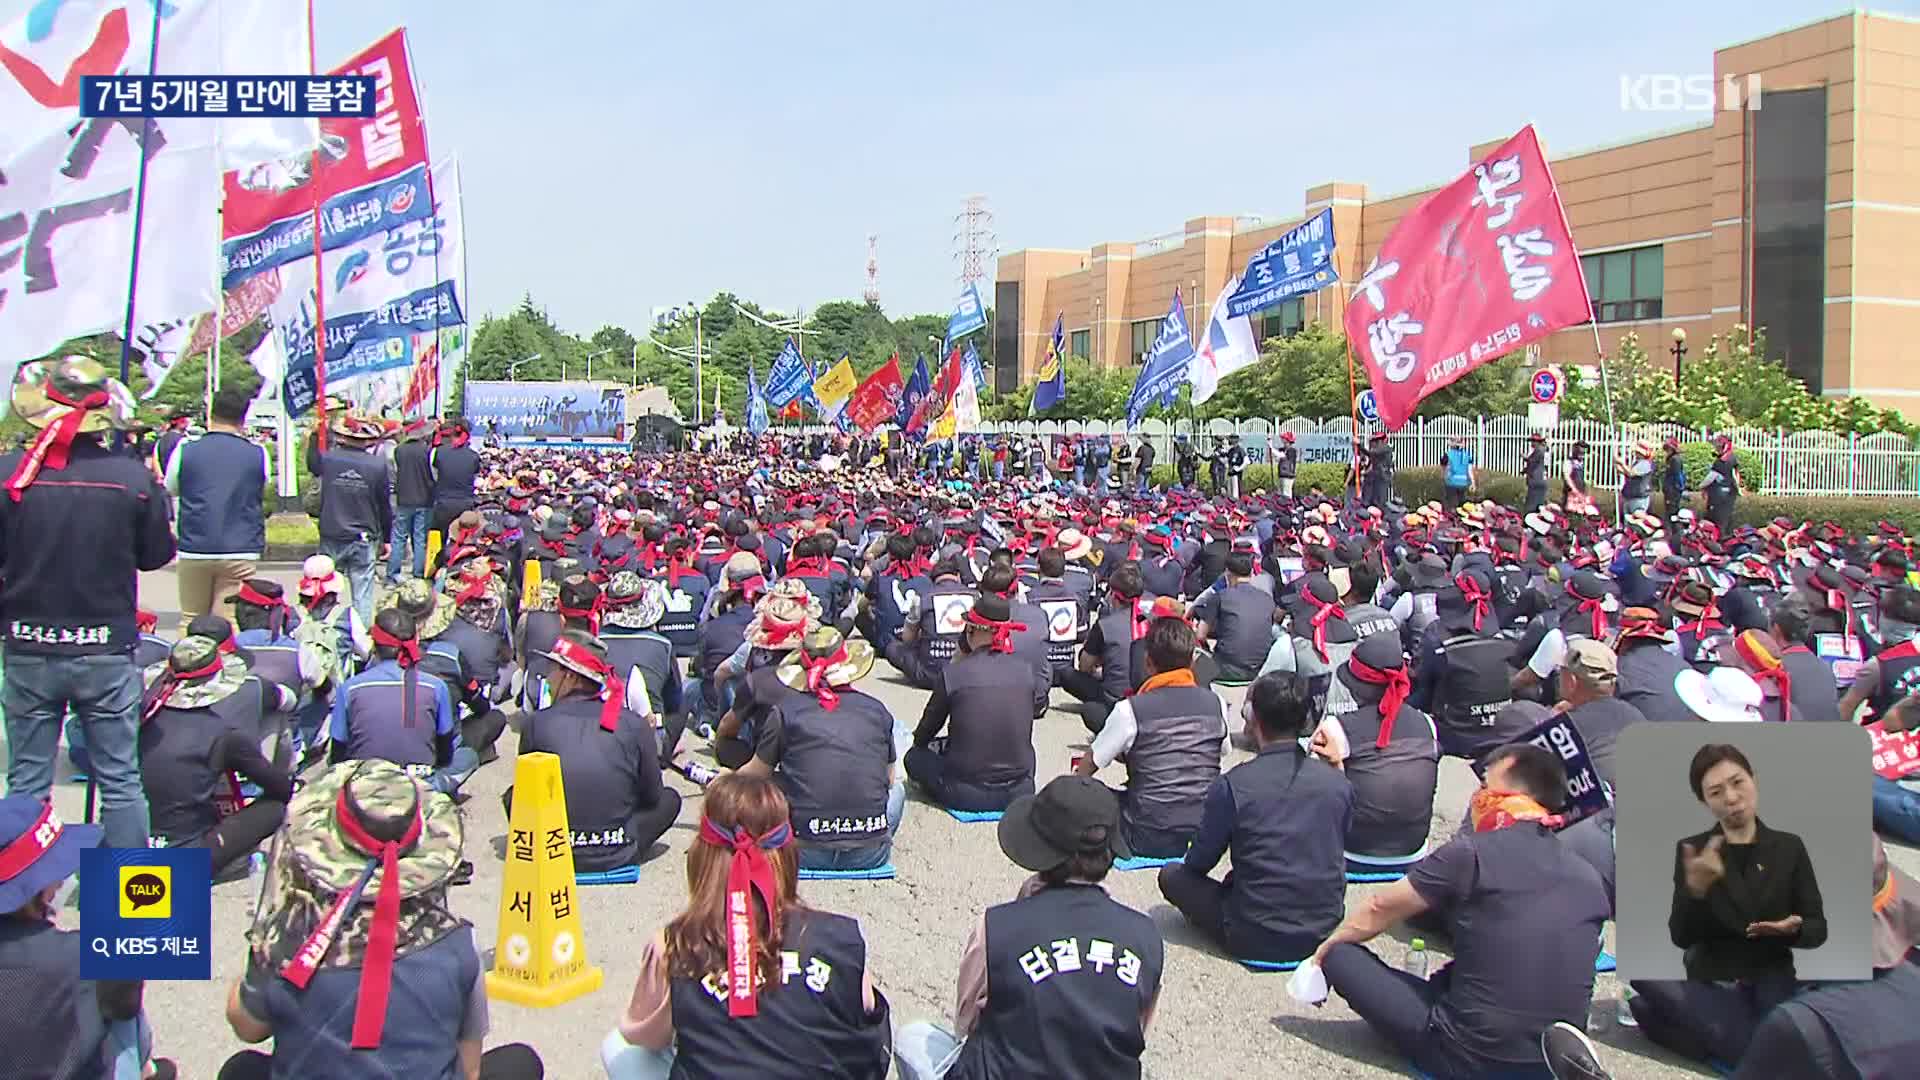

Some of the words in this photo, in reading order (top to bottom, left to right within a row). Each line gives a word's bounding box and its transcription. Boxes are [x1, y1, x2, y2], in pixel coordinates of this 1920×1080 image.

[510, 829, 534, 922] 질서
[546, 828, 571, 920] 준법
[1018, 938, 1144, 987] 단결투쟁
